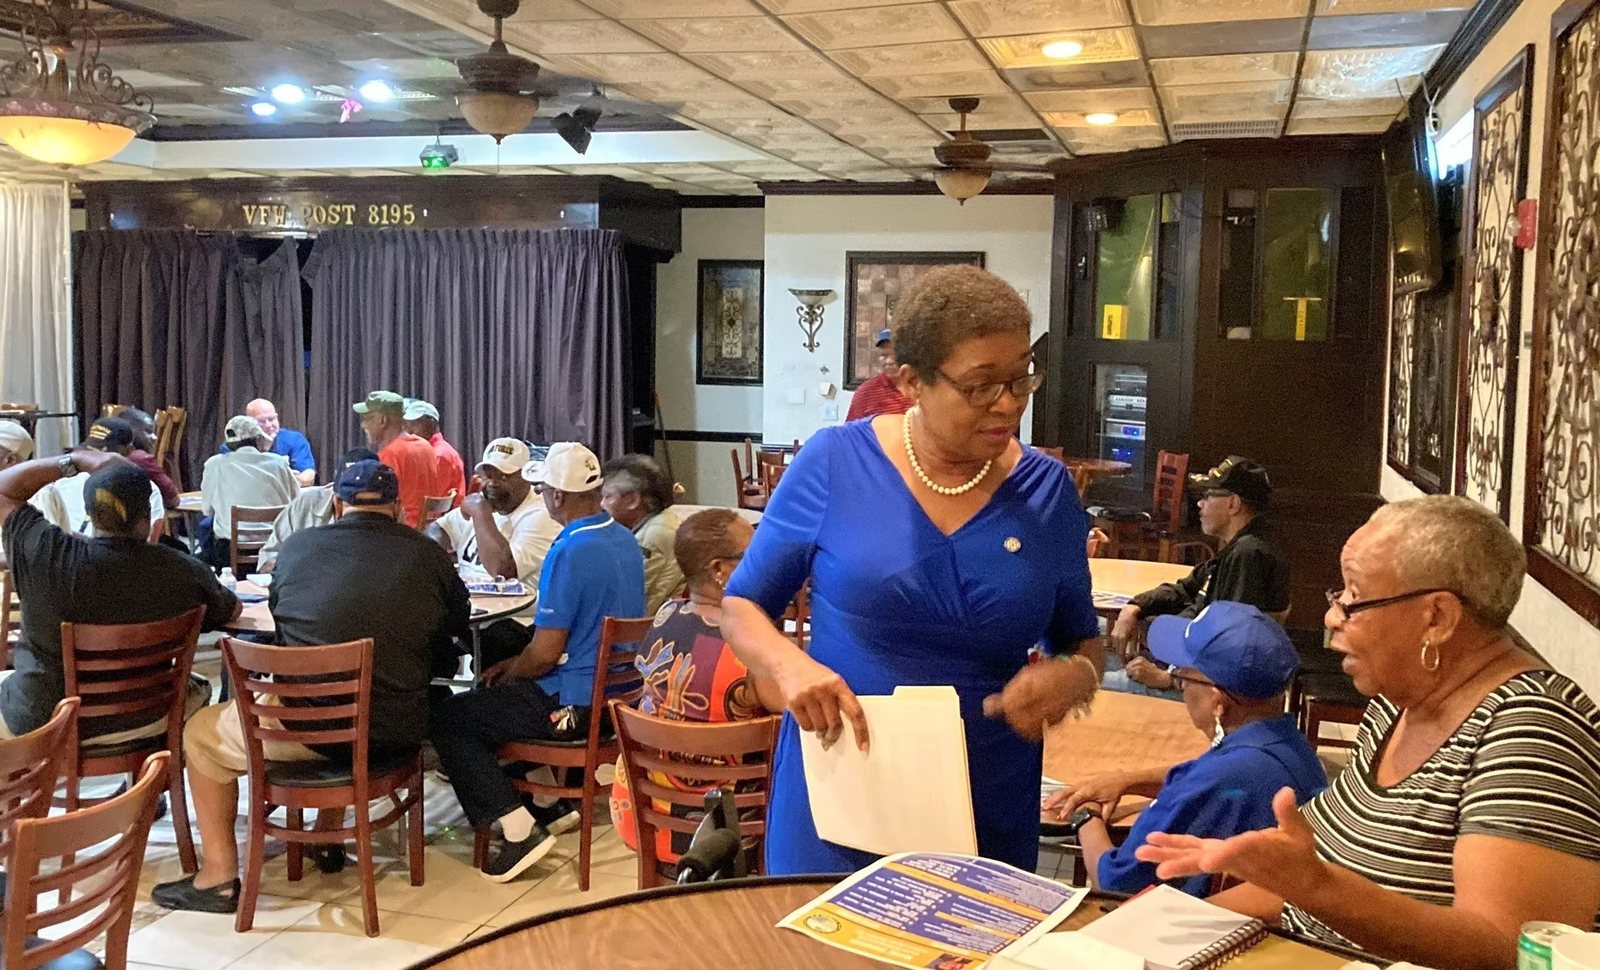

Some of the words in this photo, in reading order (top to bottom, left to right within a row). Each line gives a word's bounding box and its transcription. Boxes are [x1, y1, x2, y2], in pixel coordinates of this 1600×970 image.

[242, 204, 287, 226] VFW
[302, 204, 356, 226] POST
[368, 204, 415, 225] 8195
